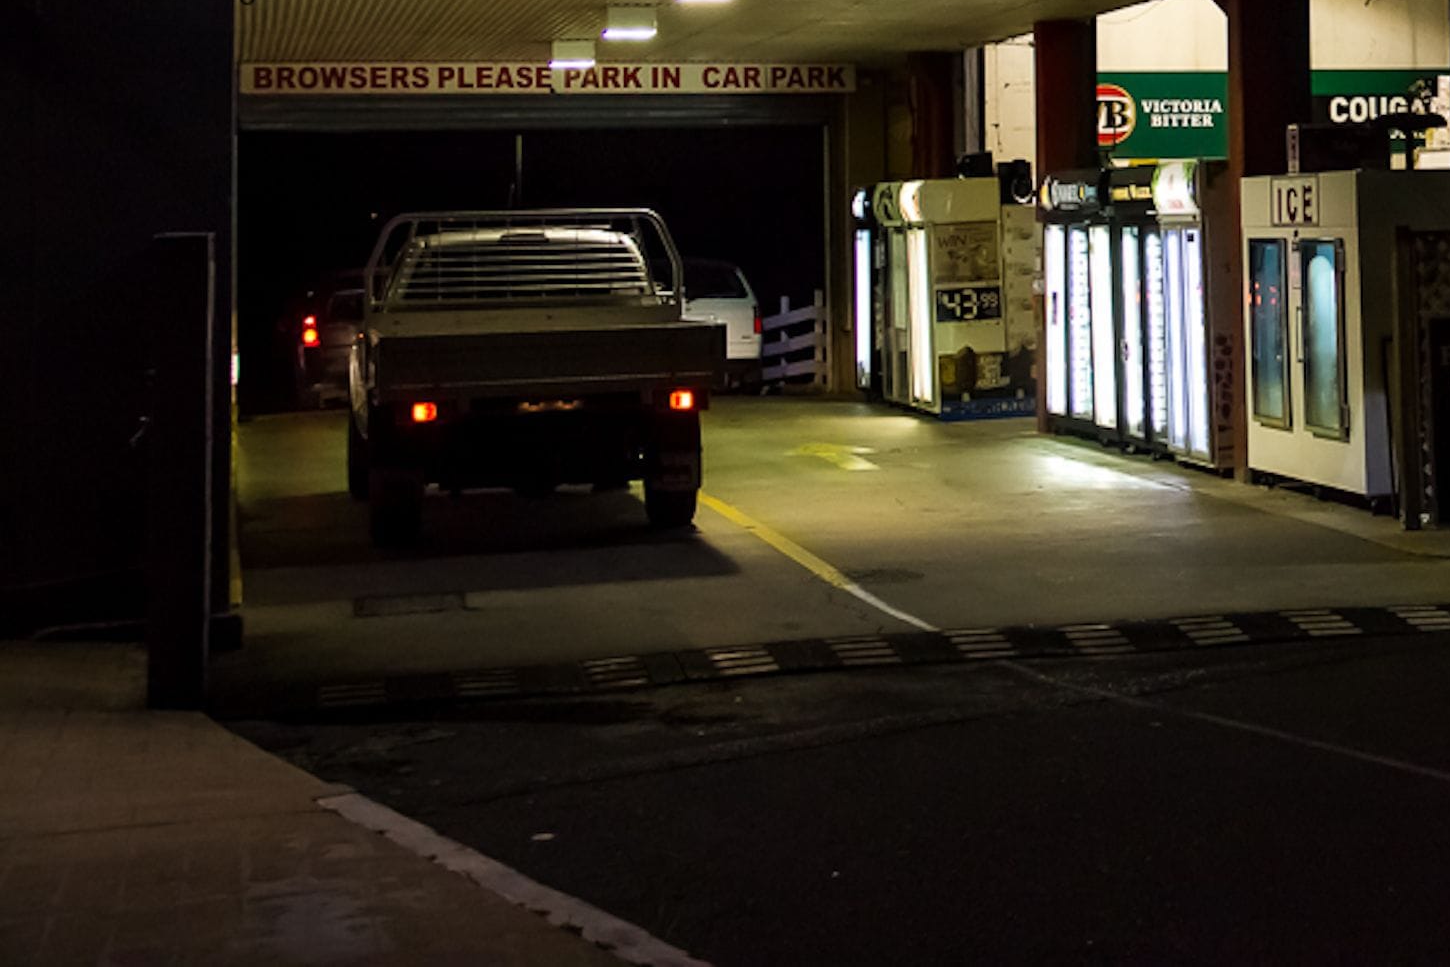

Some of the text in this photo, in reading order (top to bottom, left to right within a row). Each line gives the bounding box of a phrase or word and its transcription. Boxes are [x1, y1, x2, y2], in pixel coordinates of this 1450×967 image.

[253, 66, 846, 89] BROWSERS PLEASE PARK IN CAR PARK
[1141, 99, 1222, 114] VICTORIA
[1329, 95, 1440, 124] COUGA
[1151, 114, 1214, 128] BITTER
[1277, 185, 1313, 222] ICE
